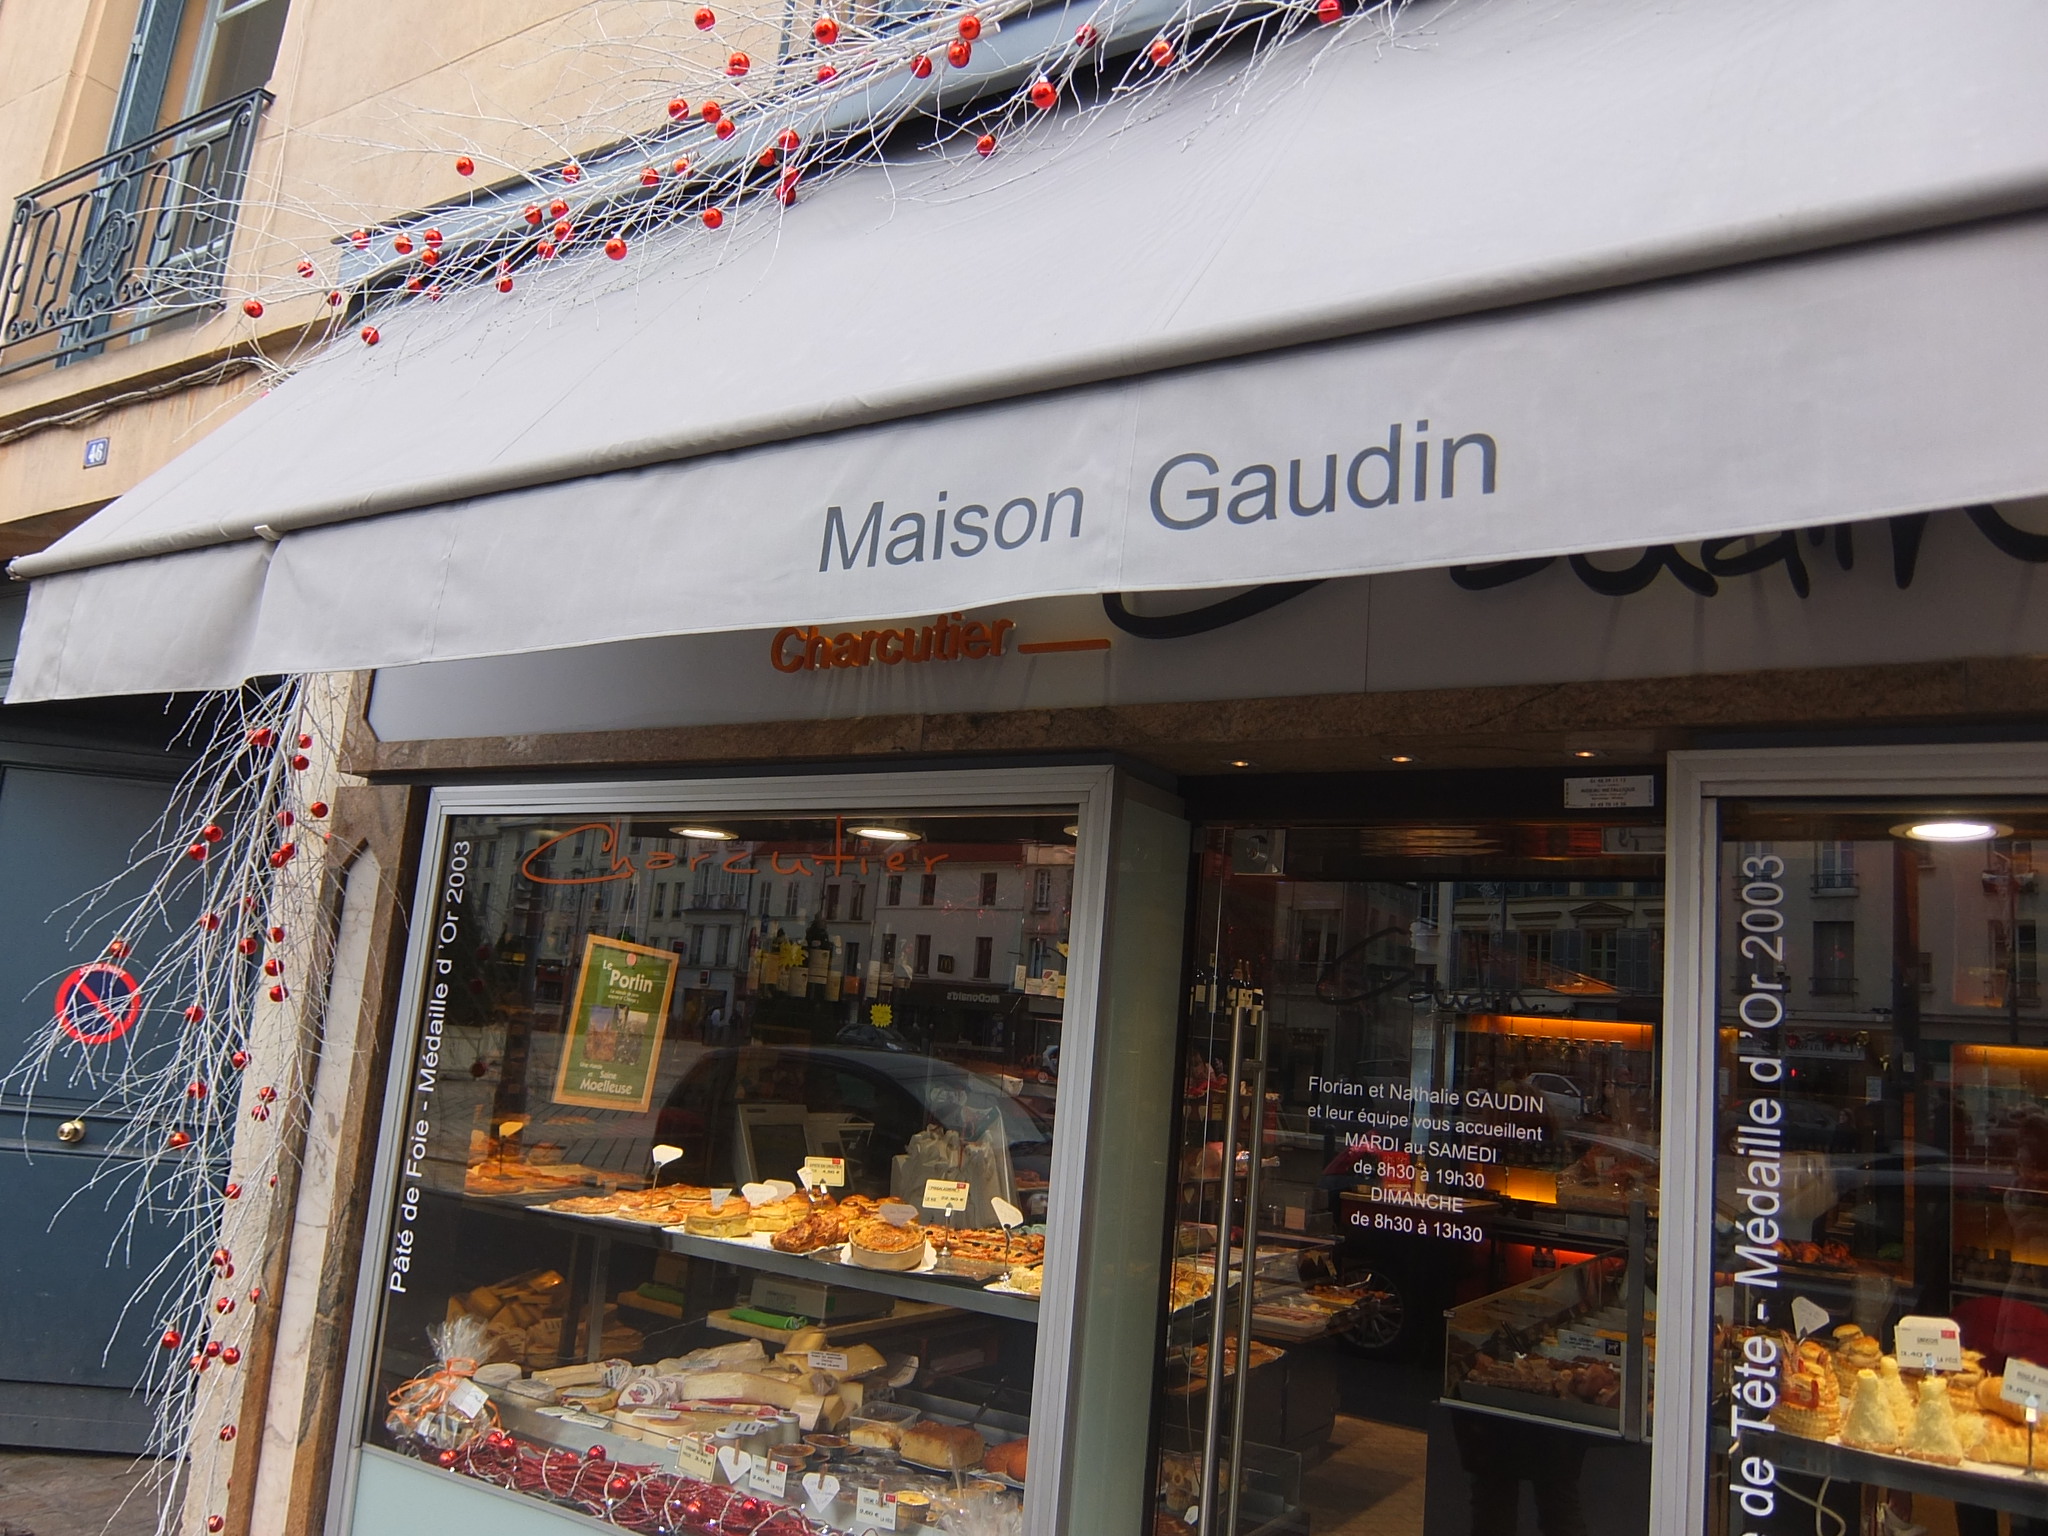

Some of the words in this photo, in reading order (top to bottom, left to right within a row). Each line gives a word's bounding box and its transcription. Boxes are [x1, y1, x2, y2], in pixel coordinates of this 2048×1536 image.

[88, 443, 104, 463] 46
[818, 486, 1085, 573] Maison
[1149, 419, 1497, 531] Gaudin
[770, 612, 1015, 673] Charcutier
[447, 840, 470, 904] 2003
[522, 815, 950, 885] Charcutier
[1740, 855, 1785, 962] 2003
[602, 959, 614, 971] Le
[609, 969, 653, 993] Porlin
[418, 982, 448, 1092] Médaille
[1739, 973, 1783, 1083] d'Or
[579, 1078, 633, 1095] Moelleuse
[1308, 1076, 1363, 1096] Florian
[1368, 1084, 1384, 1099] et
[1389, 1083, 1460, 1106] Nathalie
[1465, 1091, 1544, 1114] GAUDIN
[406, 1119, 429, 1178] Foie
[1307, 1105, 1321, 1118] et
[1325, 1105, 1353, 1121] leur
[1357, 1108, 1408, 1130] équipe
[1413, 1117, 1450, 1132] vous
[1455, 1120, 1542, 1141] accueillent
[1344, 1132, 1399, 1152] MARDI
[1404, 1140, 1423, 1155] au
[1428, 1141, 1497, 1164] SAMEDI
[1353, 1159, 1372, 1175] de
[1377, 1161, 1415, 1180] 8h30
[1420, 1166, 1430, 1182] à
[1436, 1169, 1485, 1189] 19h30
[1370, 1187, 1464, 1213] DIMANCHE
[1734, 1098, 1782, 1288] Médaille
[401, 1187, 420, 1221] de
[1350, 1211, 1370, 1227] de
[1374, 1213, 1413, 1233] 8h30
[1417, 1219, 1427, 1235] à
[1433, 1221, 1482, 1243] 13h30
[390, 1229, 414, 1292] Pâté
[1731, 1335, 1777, 1437] Tête
[1729, 1456, 1775, 1516] de
